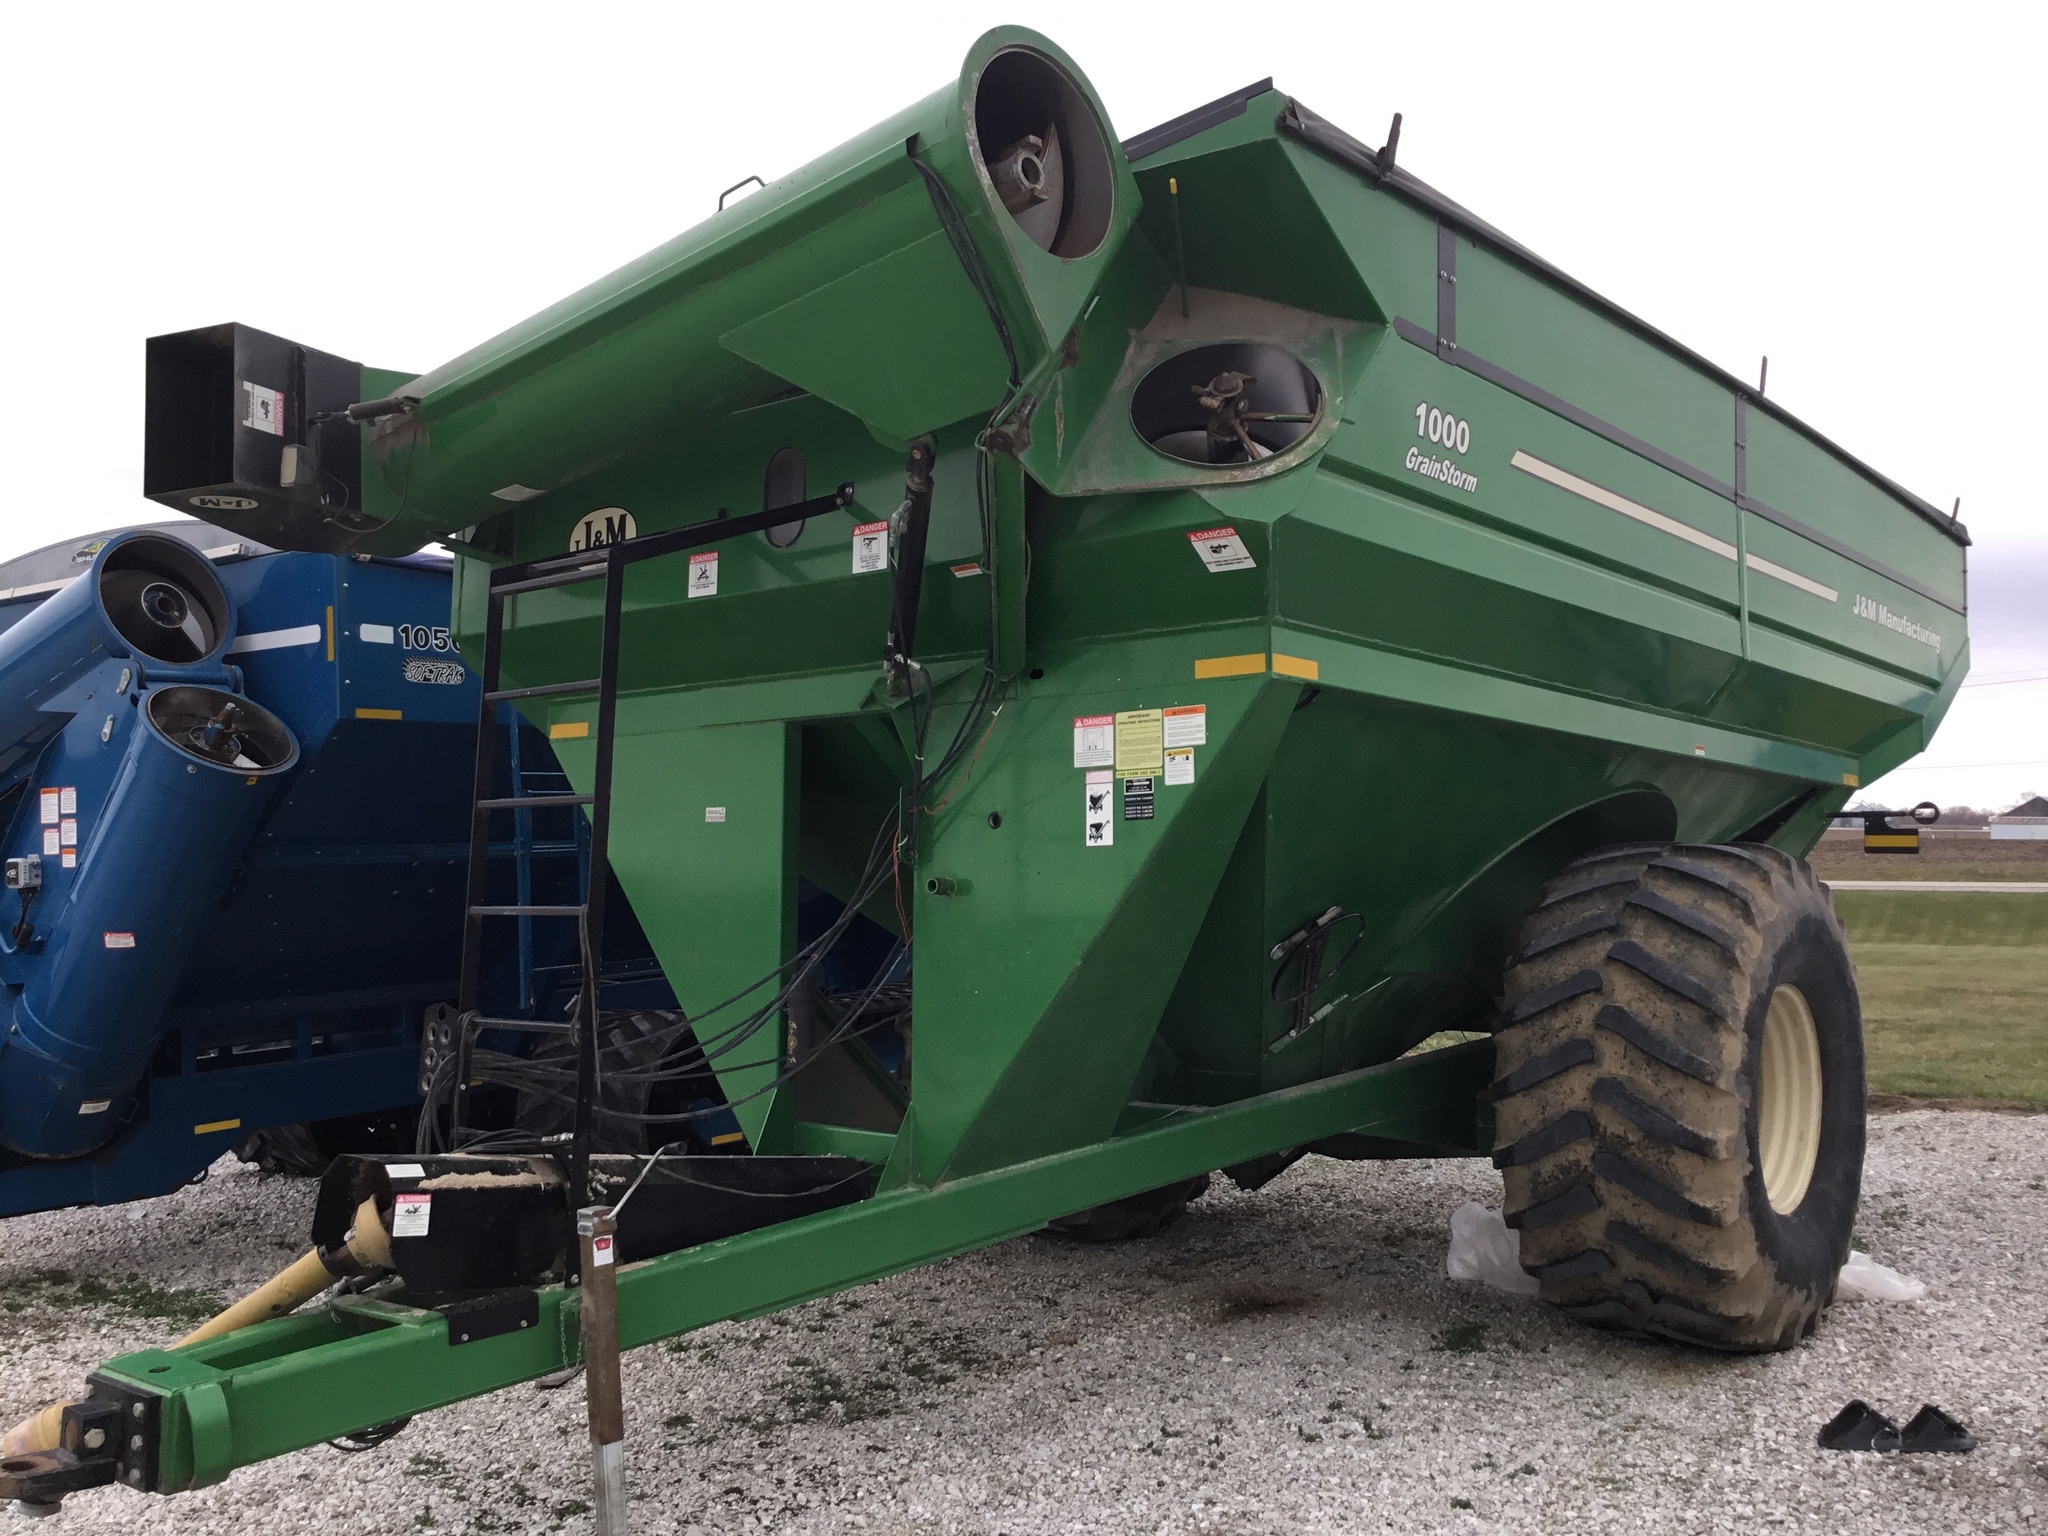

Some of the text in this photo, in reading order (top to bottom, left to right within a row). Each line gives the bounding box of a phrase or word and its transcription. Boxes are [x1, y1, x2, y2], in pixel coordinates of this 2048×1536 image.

[275, 400, 284, 435] DANGER
[1414, 402, 1470, 454] 1000
[1405, 446, 1478, 493] GrainStorm
[575, 513, 628, 551] J&M
[860, 521, 888, 534] DANGER
[1197, 528, 1236, 540] DANGER
[695, 552, 718, 563] DANGER
[1853, 594, 1941, 654] J&M Manufacturing
[1083, 717, 1113, 726] DANGER
[404, 1194, 430, 1202] DANGER
